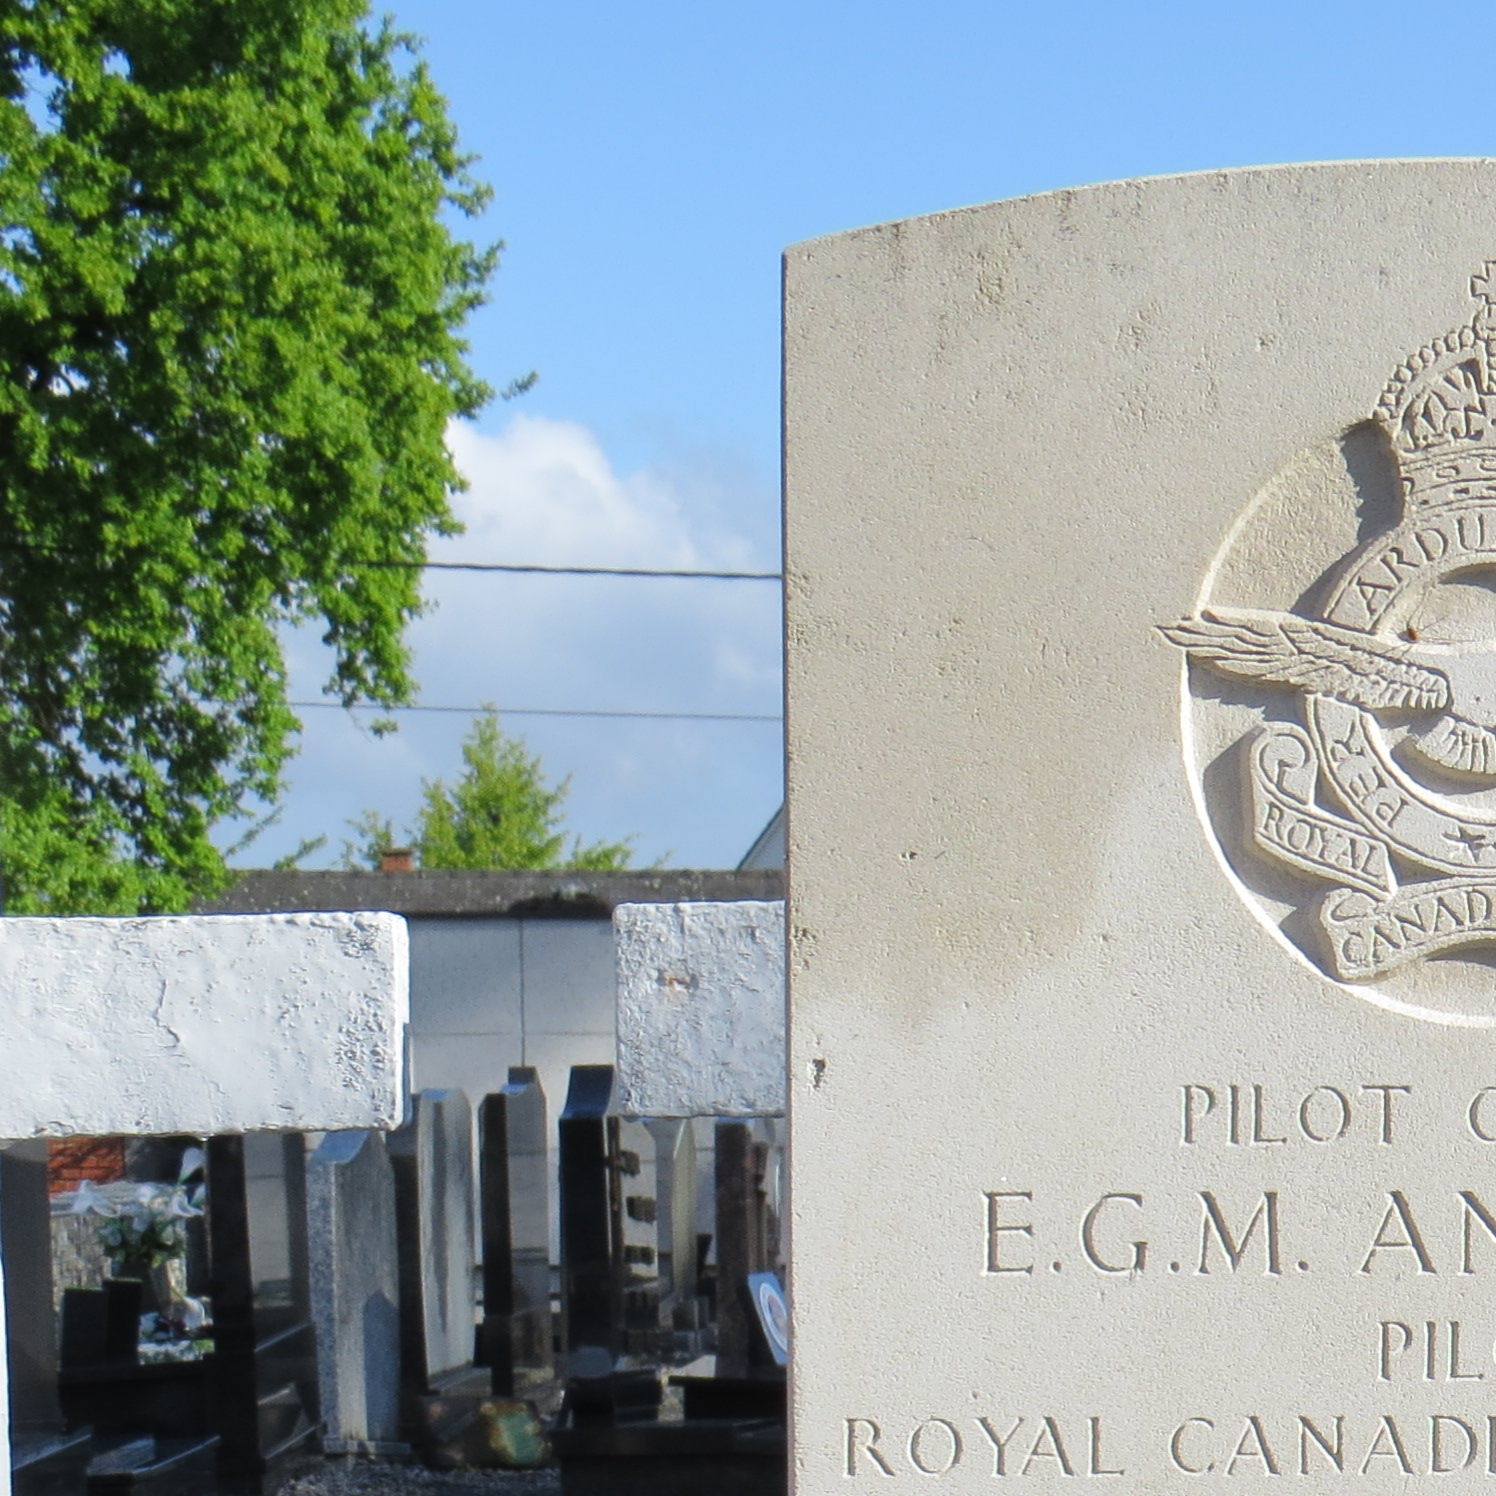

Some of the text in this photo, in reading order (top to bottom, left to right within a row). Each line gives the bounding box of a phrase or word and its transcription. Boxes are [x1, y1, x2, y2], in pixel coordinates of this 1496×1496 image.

[1331, 719, 1410, 829] PER
[1263, 801, 1383, 880] ROYAL
[1180, 1083, 1412, 1146] PILOT
[981, 1189, 1309, 1276] E.G.M.
[842, 1415, 1126, 1478] ROYAL
